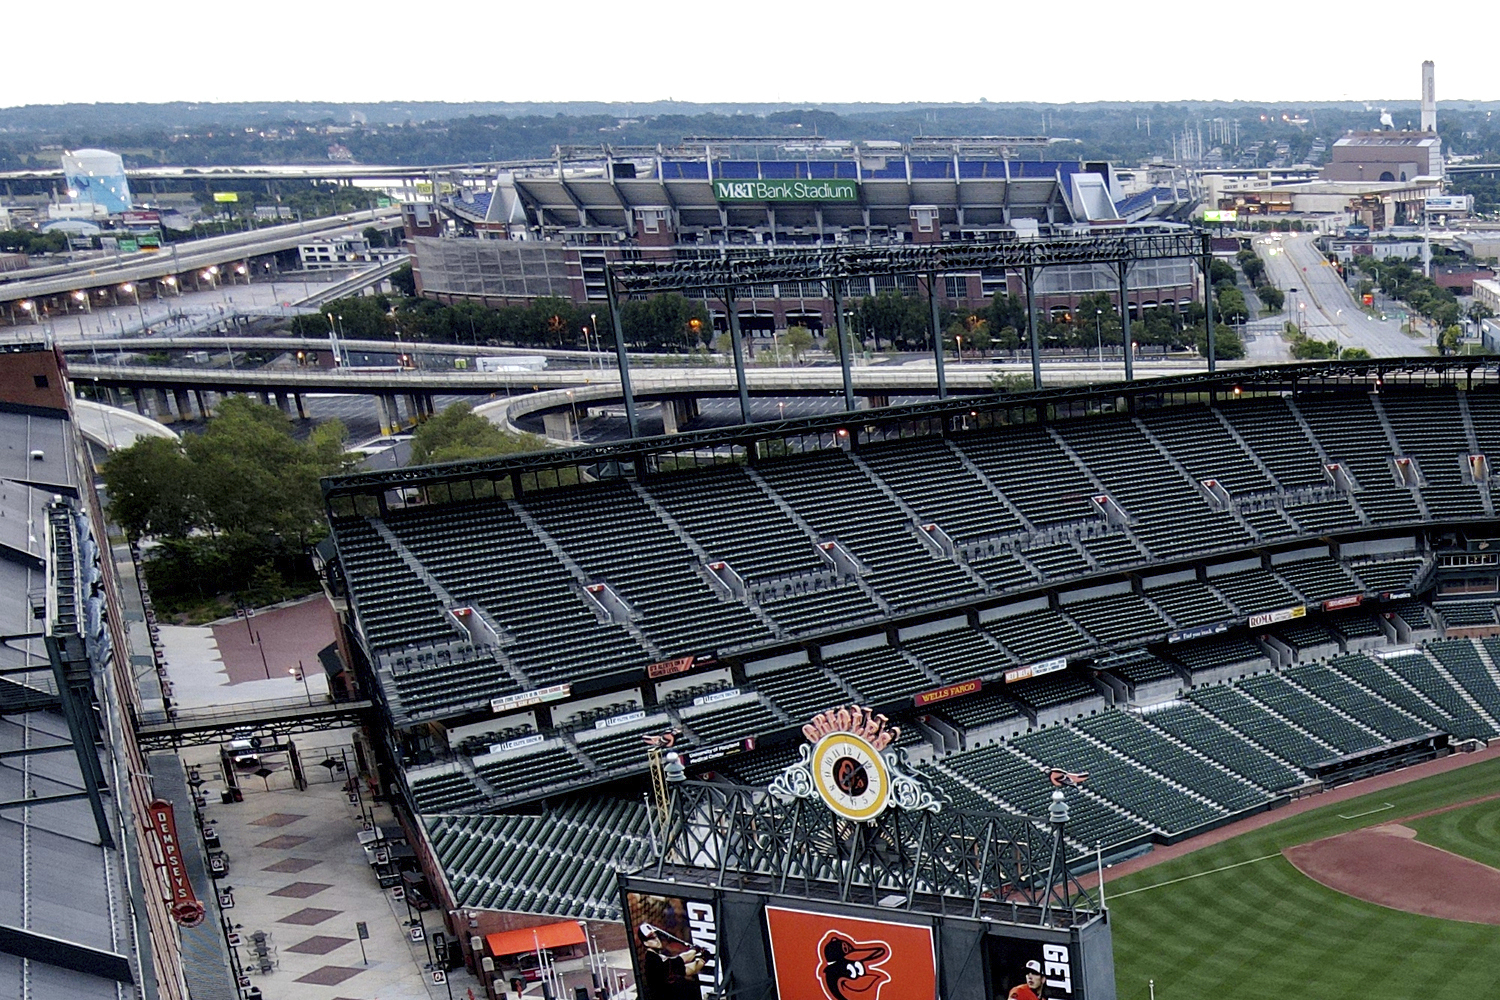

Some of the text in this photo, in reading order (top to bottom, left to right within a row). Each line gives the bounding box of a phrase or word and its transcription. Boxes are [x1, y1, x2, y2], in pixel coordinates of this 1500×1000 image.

[717, 182, 853, 198] M&T Bank Stadium
[1250, 614, 1273, 626] ROMA
[921, 683, 976, 702] WELLS FARGO
[157, 812, 187, 898] DEMPSEYS
[1042, 943, 1072, 994] GET
